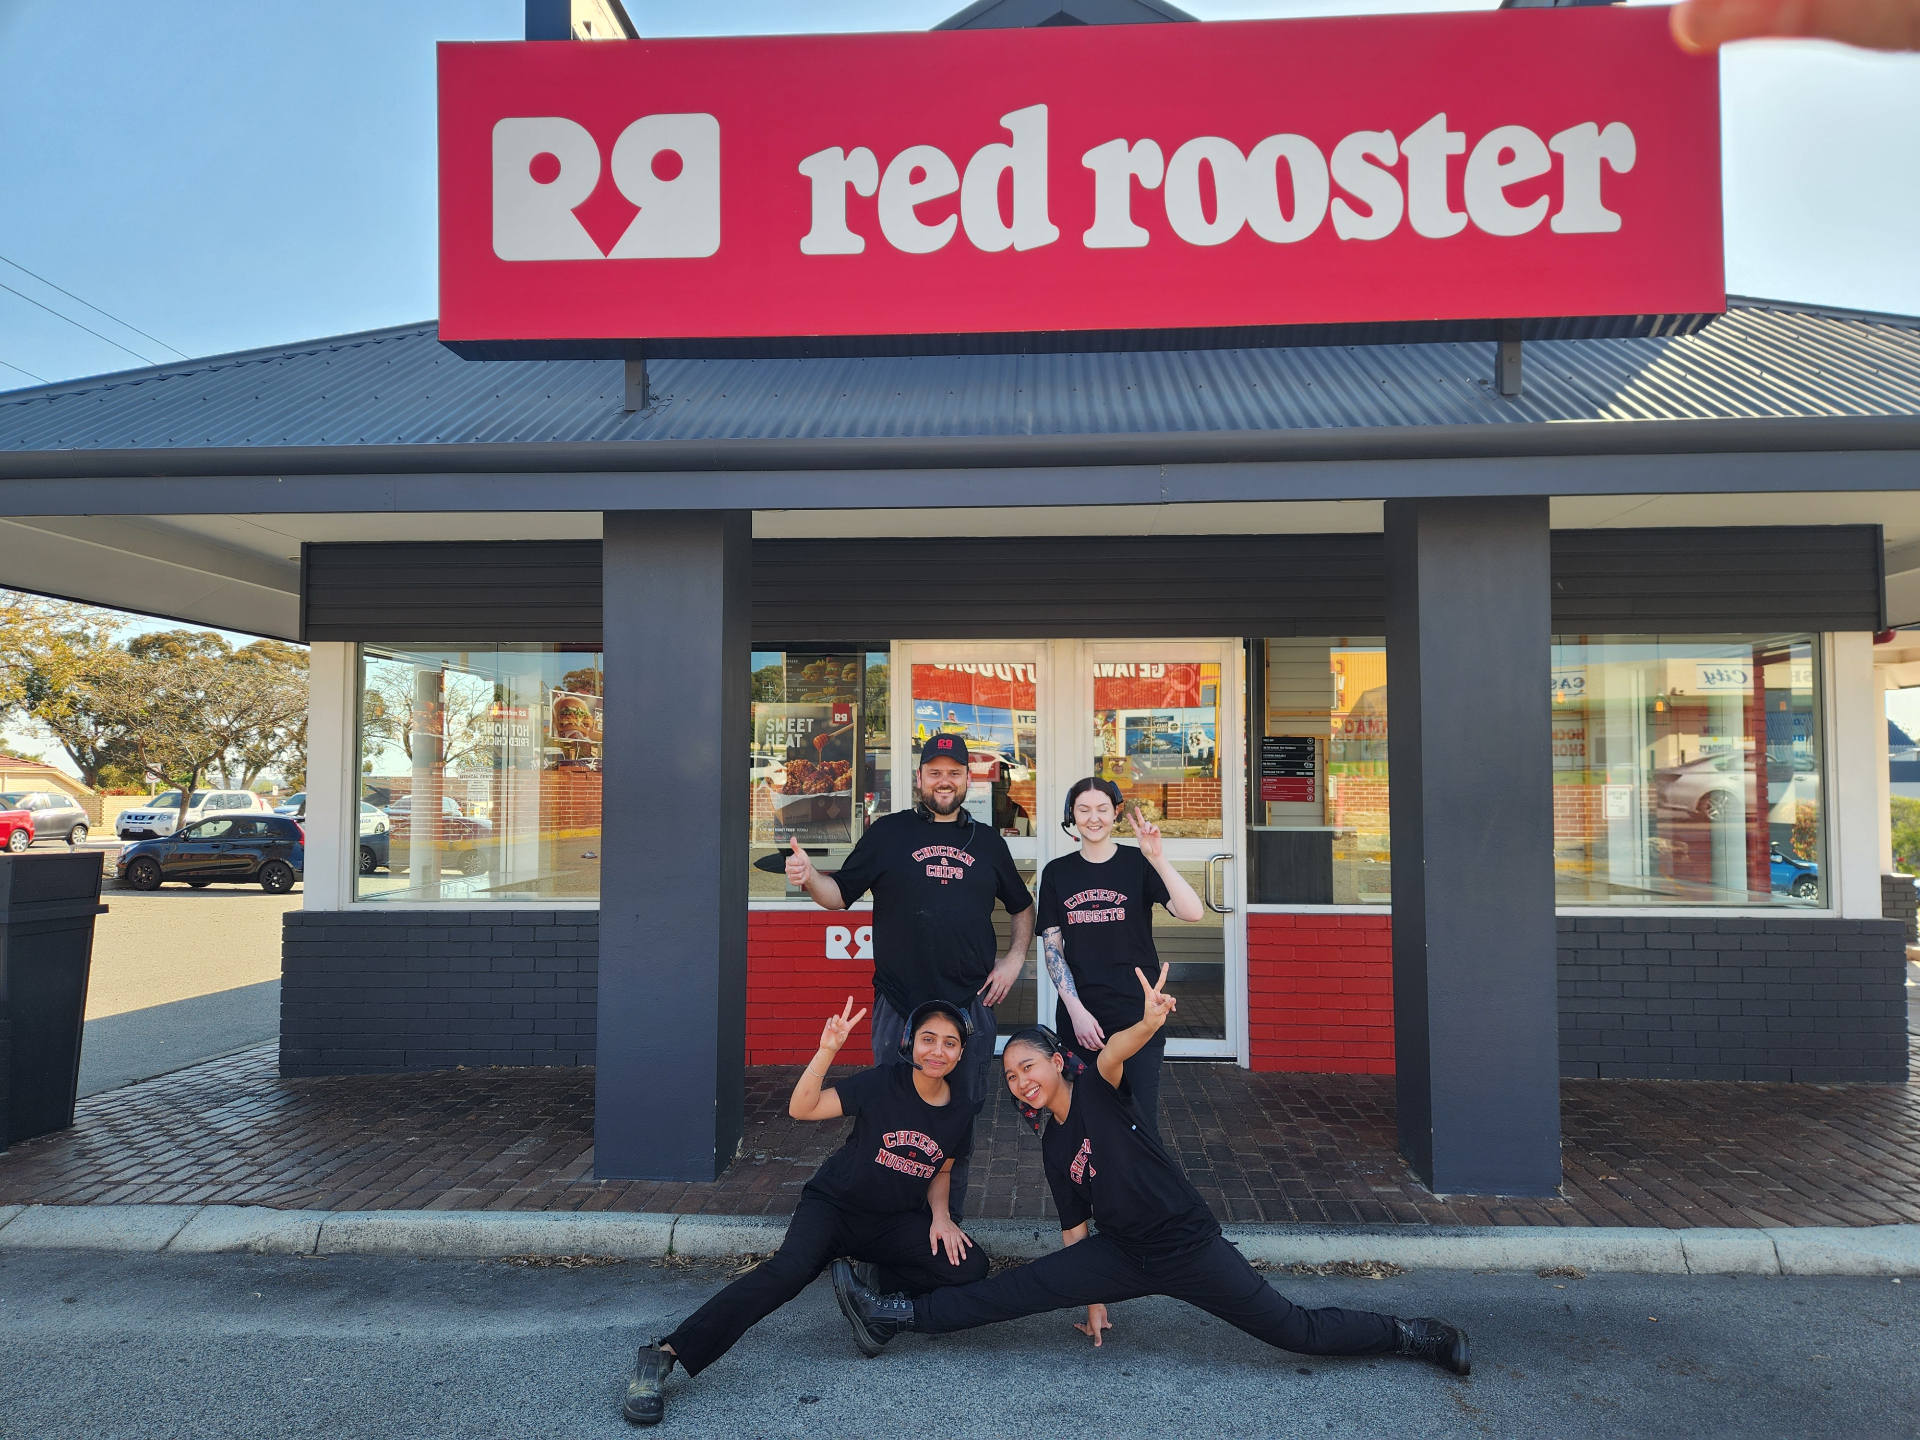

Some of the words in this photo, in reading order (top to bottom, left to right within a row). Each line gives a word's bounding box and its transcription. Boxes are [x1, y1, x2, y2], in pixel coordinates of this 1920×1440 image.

[798, 102, 1060, 257] red
[1081, 111, 1637, 249] rooster
[766, 718, 814, 733] SWEET
[765, 733, 803, 748] HEAT
[911, 845, 976, 867] CHICKEN
[940, 857, 949, 866] &
[926, 864, 964, 880] CHIPS
[1063, 888, 1128, 910] CHEESY
[1066, 907, 1126, 925] NUGGETS
[882, 1130, 944, 1164] CHEESY
[874, 1147, 936, 1179] NUGGETS
